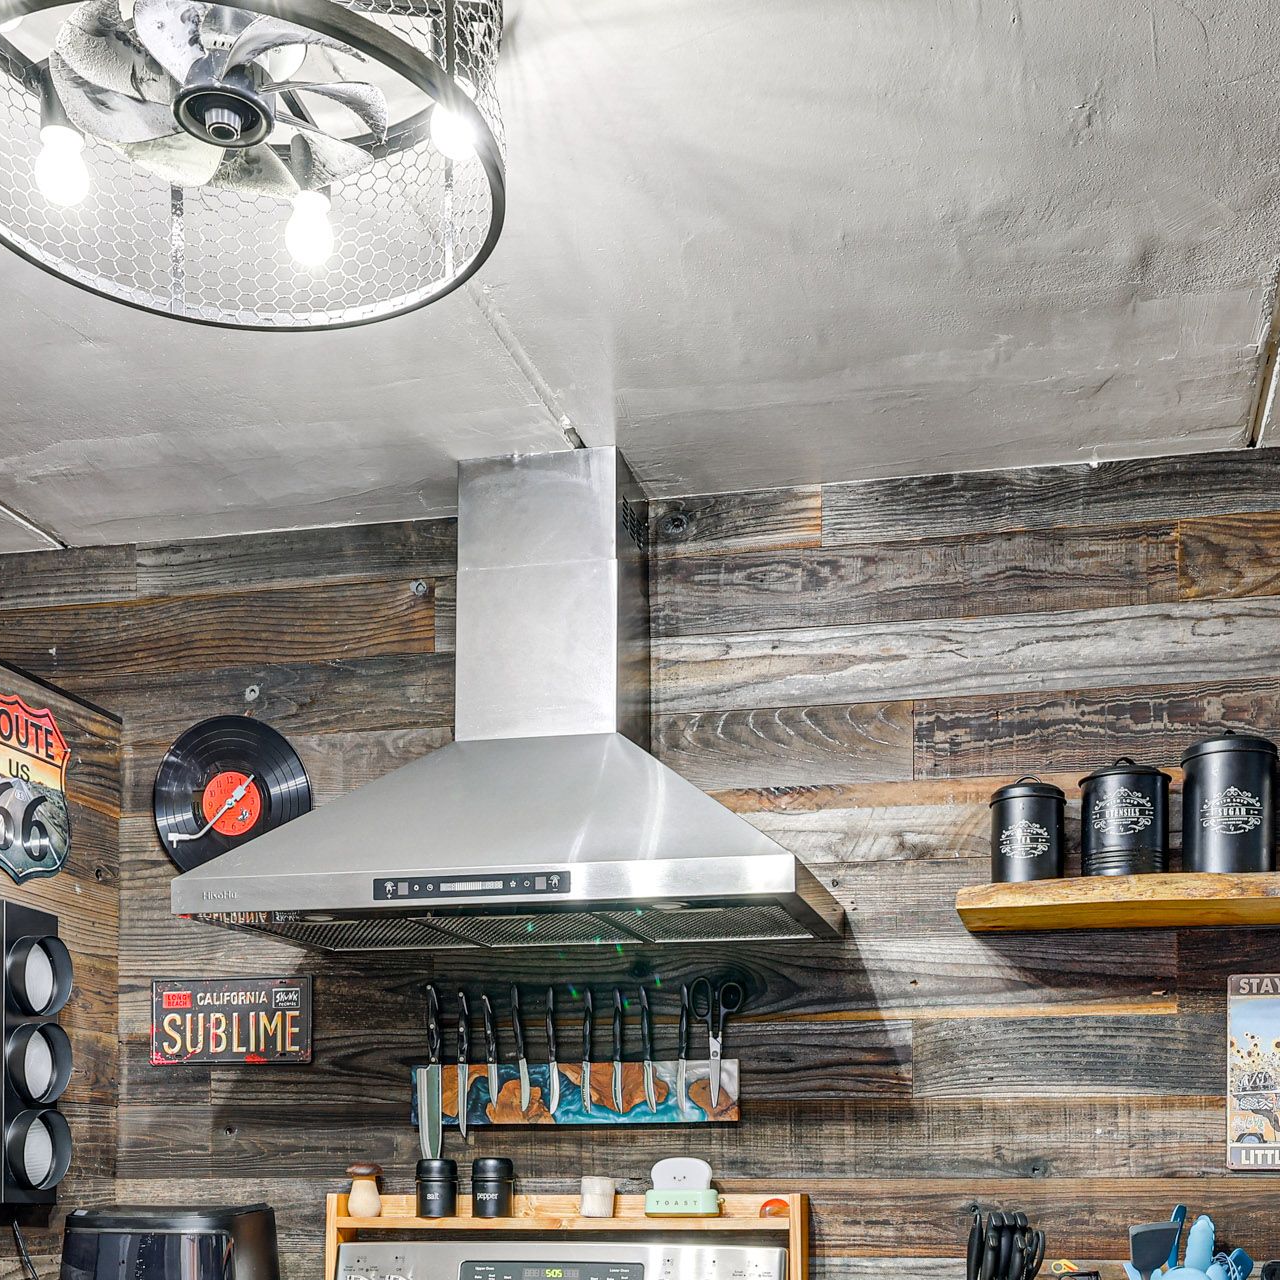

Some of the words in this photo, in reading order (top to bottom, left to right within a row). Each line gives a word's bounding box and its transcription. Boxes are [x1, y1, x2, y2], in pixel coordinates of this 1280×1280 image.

[8, 758, 30, 782] US
[1105, 808, 1139, 818] UTENSILS
[1218, 807, 1246, 816] SUGAR
[197, 991, 268, 1005] CALIFORNIA
[162, 1010, 300, 1054] SUBLIME
[476, 1193, 499, 1202] pepper
[545, 1269, 563, 1278] 5:05
